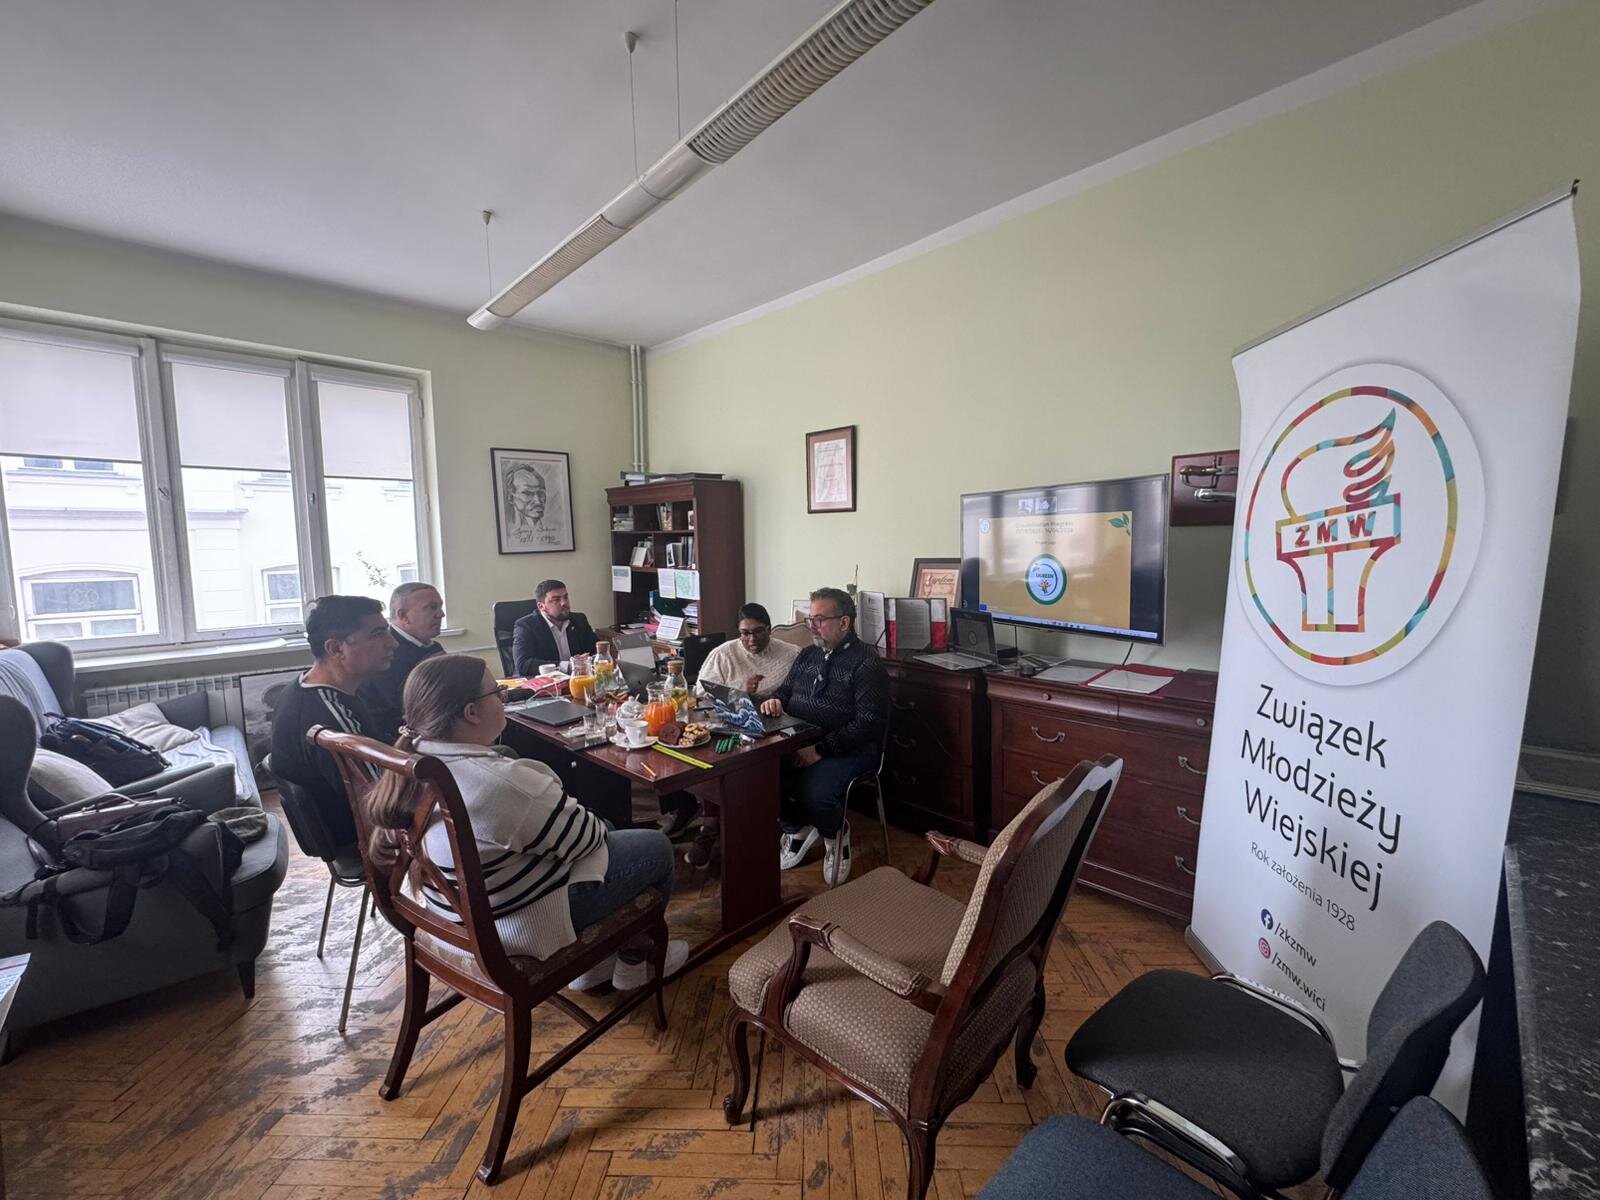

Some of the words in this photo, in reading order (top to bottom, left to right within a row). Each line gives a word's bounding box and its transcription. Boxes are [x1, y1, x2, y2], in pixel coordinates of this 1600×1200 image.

[1294, 510, 1377, 548] ZMW
[1256, 683, 1388, 769] Związek
[1240, 728, 1402, 855] Młodzieży
[1245, 780, 1384, 912] Wiejskiej
[1250, 841, 1270, 866] Rok
[1271, 860, 1323, 907] założenia
[1325, 898, 1356, 932] 1928
[1271, 951, 1326, 1012] /zmw.wici
[1274, 922, 1318, 967] /zkzmw
